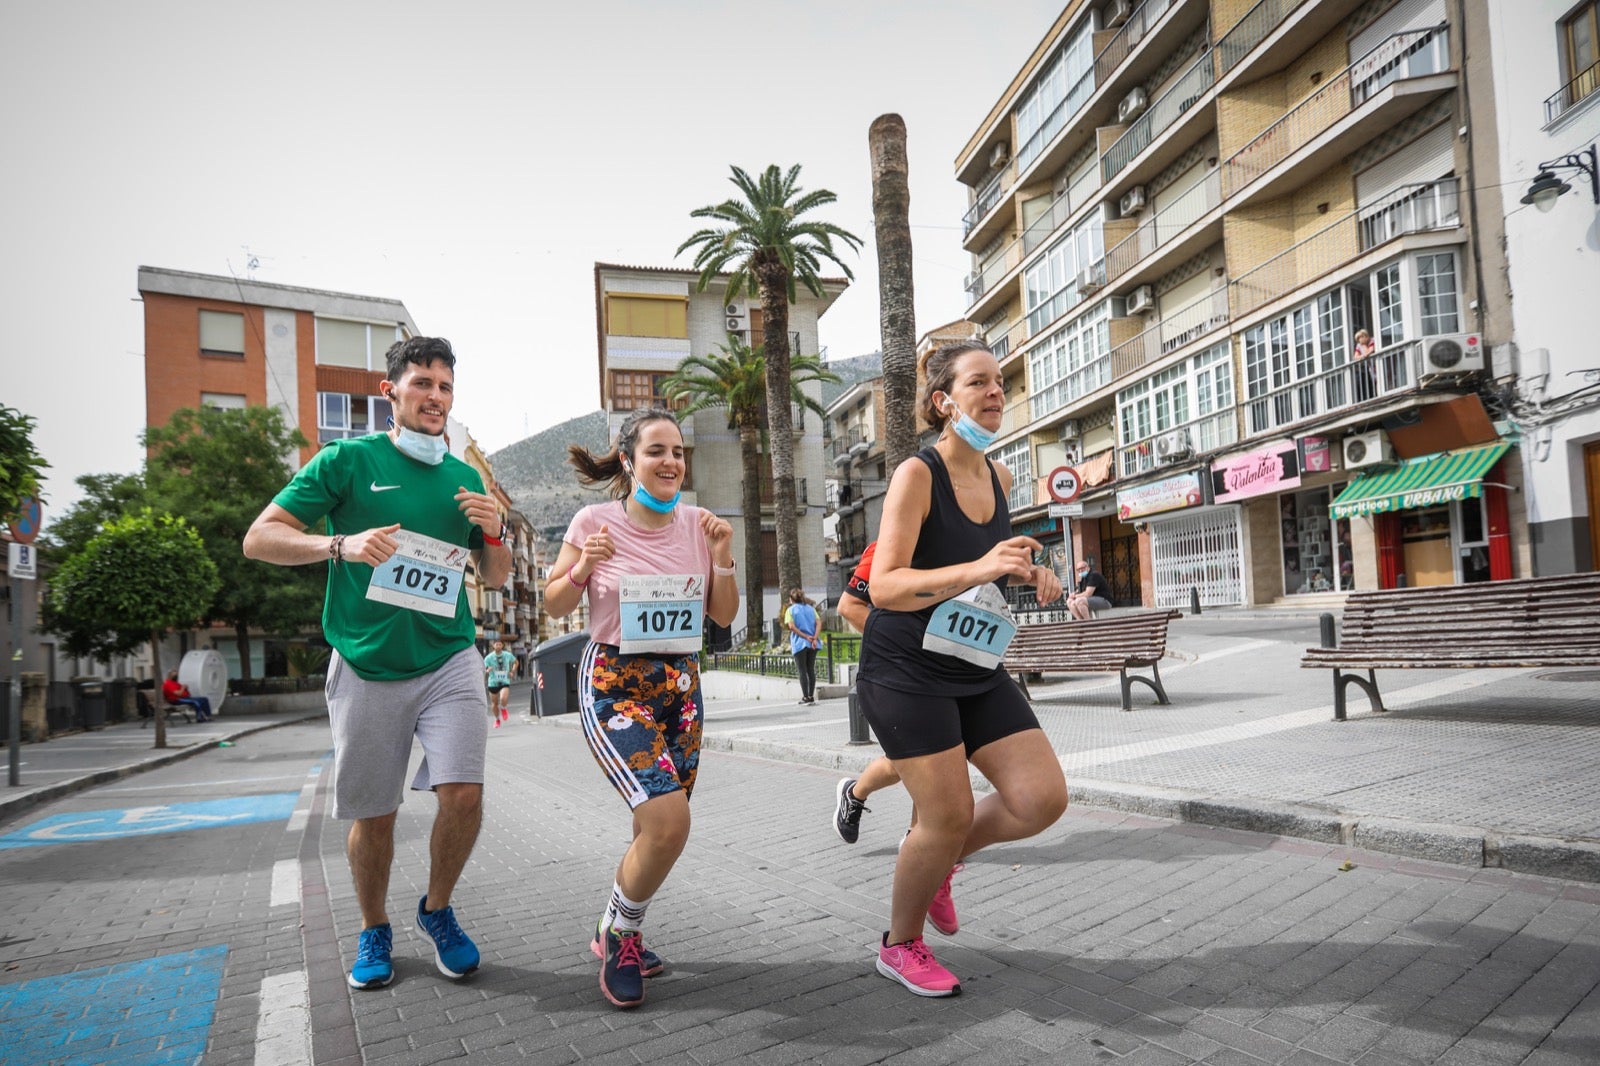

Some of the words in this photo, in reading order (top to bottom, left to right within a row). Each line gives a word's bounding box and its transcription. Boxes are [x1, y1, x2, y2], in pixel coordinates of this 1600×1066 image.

[1230, 461, 1276, 490] Valentina
[1403, 485, 1465, 507] URBANO
[392, 564, 449, 596] 1073
[637, 609, 692, 633] 1072
[947, 610, 999, 646] 1071
